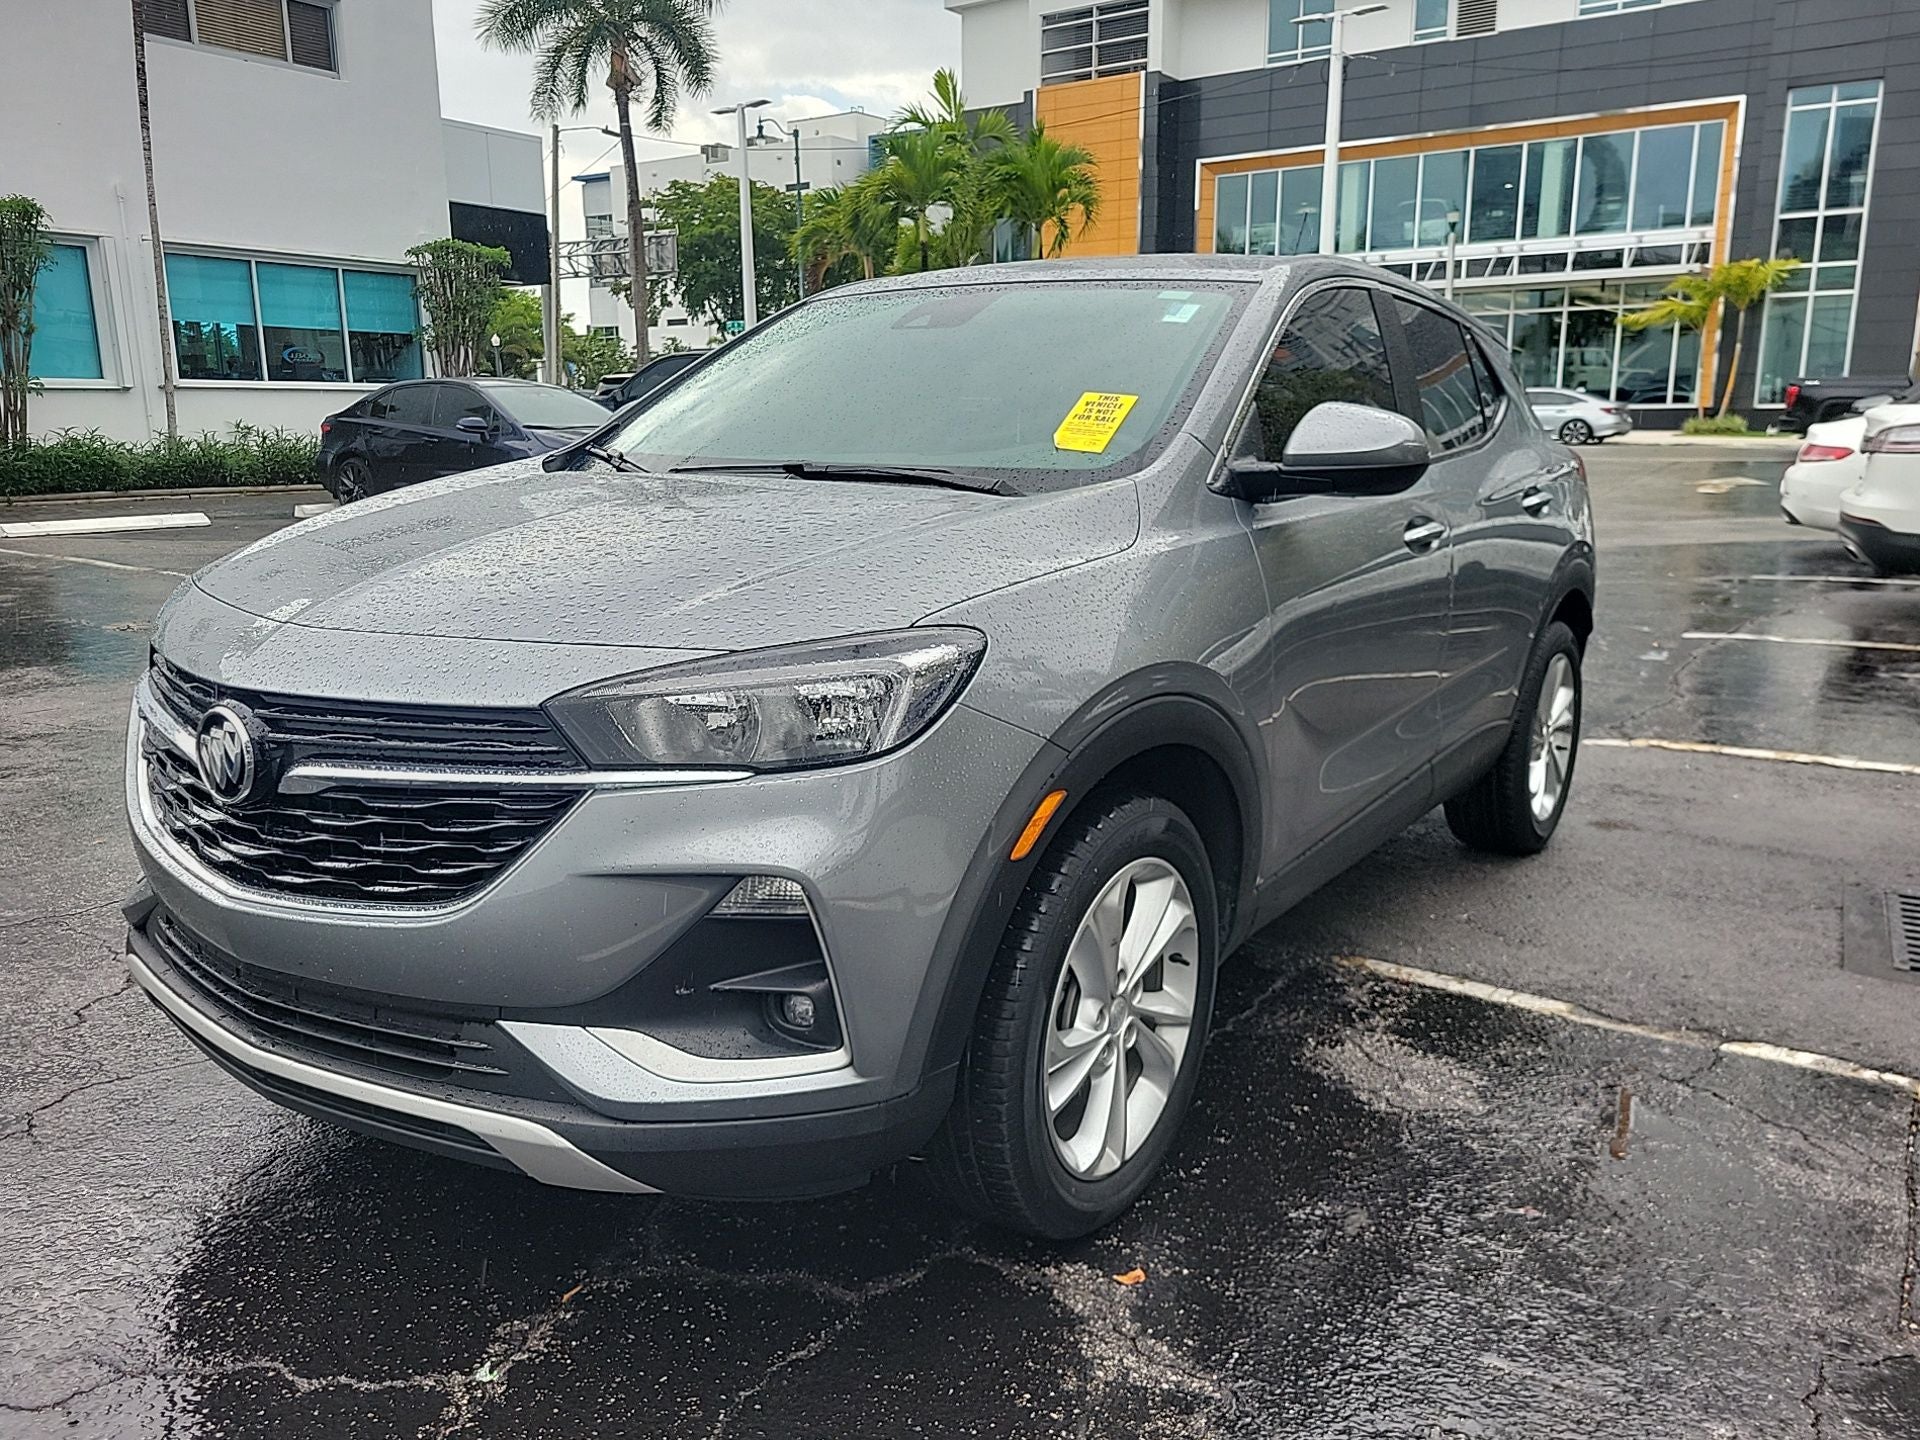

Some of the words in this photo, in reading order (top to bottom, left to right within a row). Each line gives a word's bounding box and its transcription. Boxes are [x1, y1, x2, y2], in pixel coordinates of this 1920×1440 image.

[1085, 401, 1123, 409] VEHICLE
[1096, 408, 1116, 416] NOT
[1072, 413, 1092, 421] FOR
[1093, 415, 1117, 423] SALE
